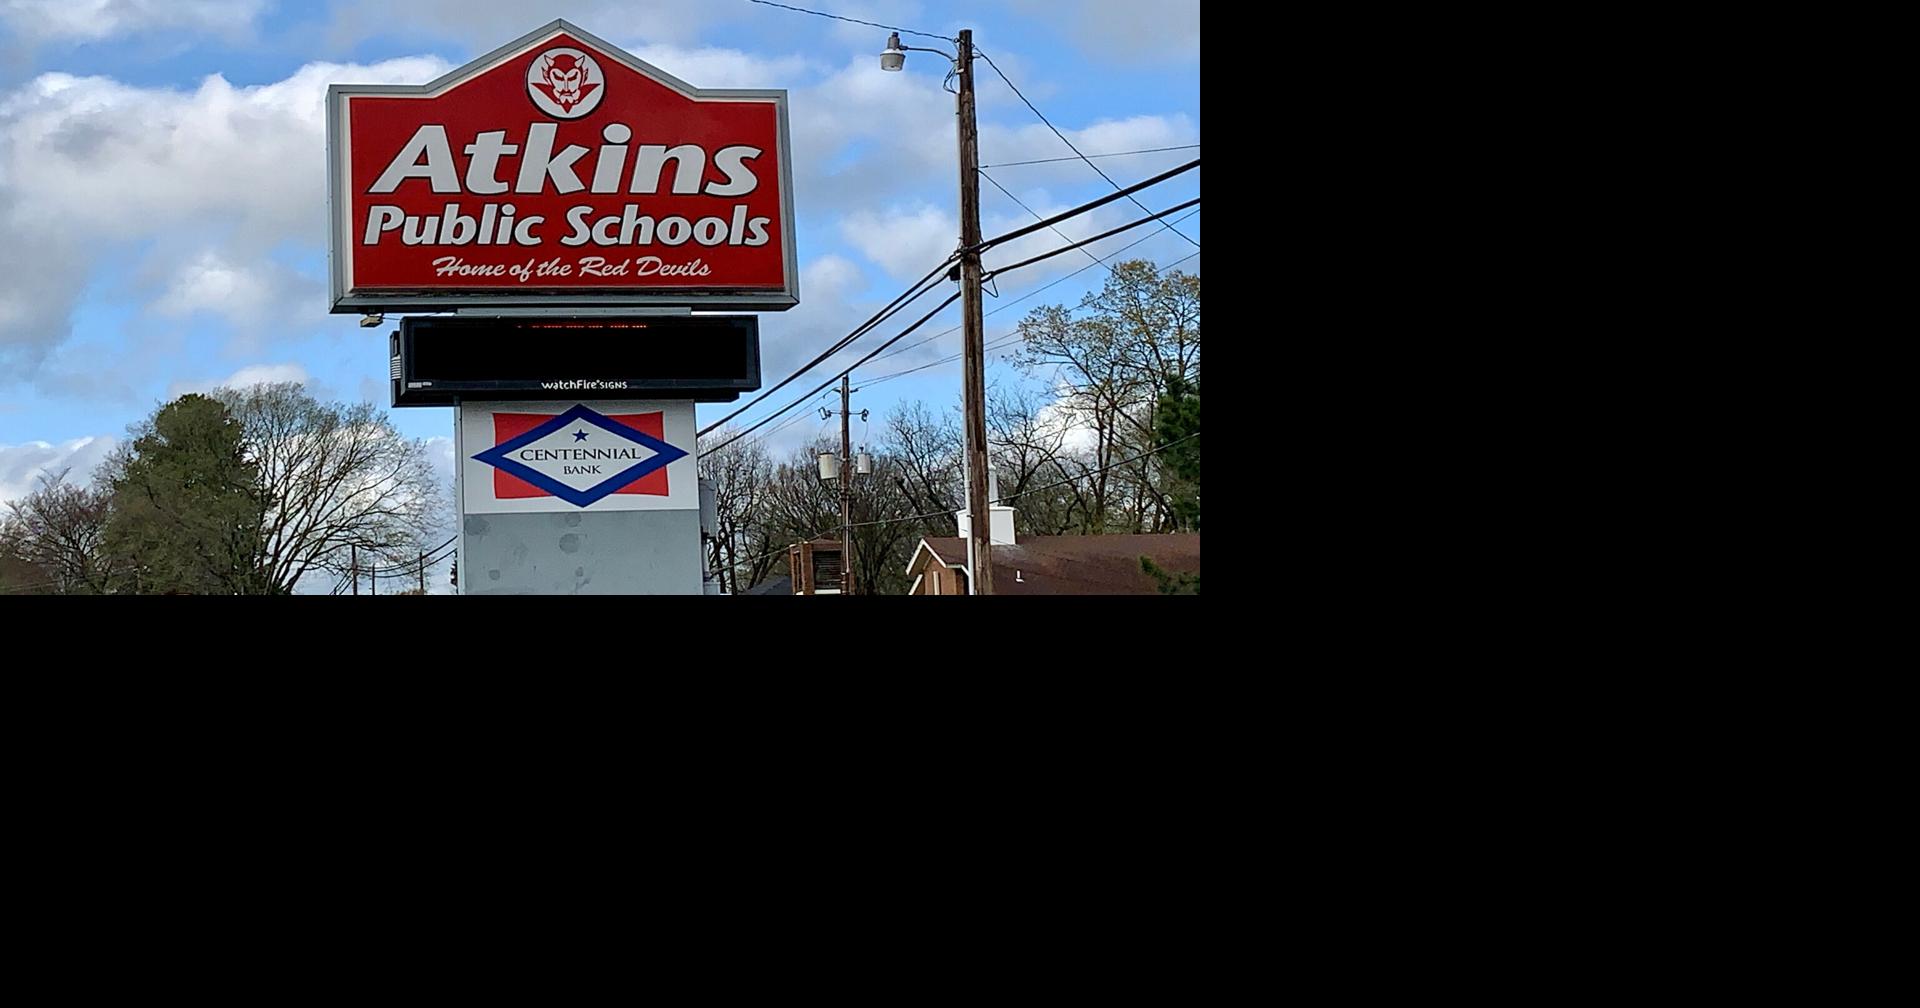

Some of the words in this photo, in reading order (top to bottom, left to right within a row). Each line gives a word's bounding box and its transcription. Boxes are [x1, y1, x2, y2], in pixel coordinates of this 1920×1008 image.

[367, 122, 763, 197] Atkins
[363, 203, 545, 246] Public
[559, 203, 771, 247] Schools
[432, 256, 506, 276] Home
[508, 258, 534, 282] of
[535, 257, 573, 277] the
[578, 256, 630, 277] Red
[636, 256, 712, 276] Devils
[520, 448, 642, 461] CENTENNIAL
[563, 465, 602, 475] BANK
